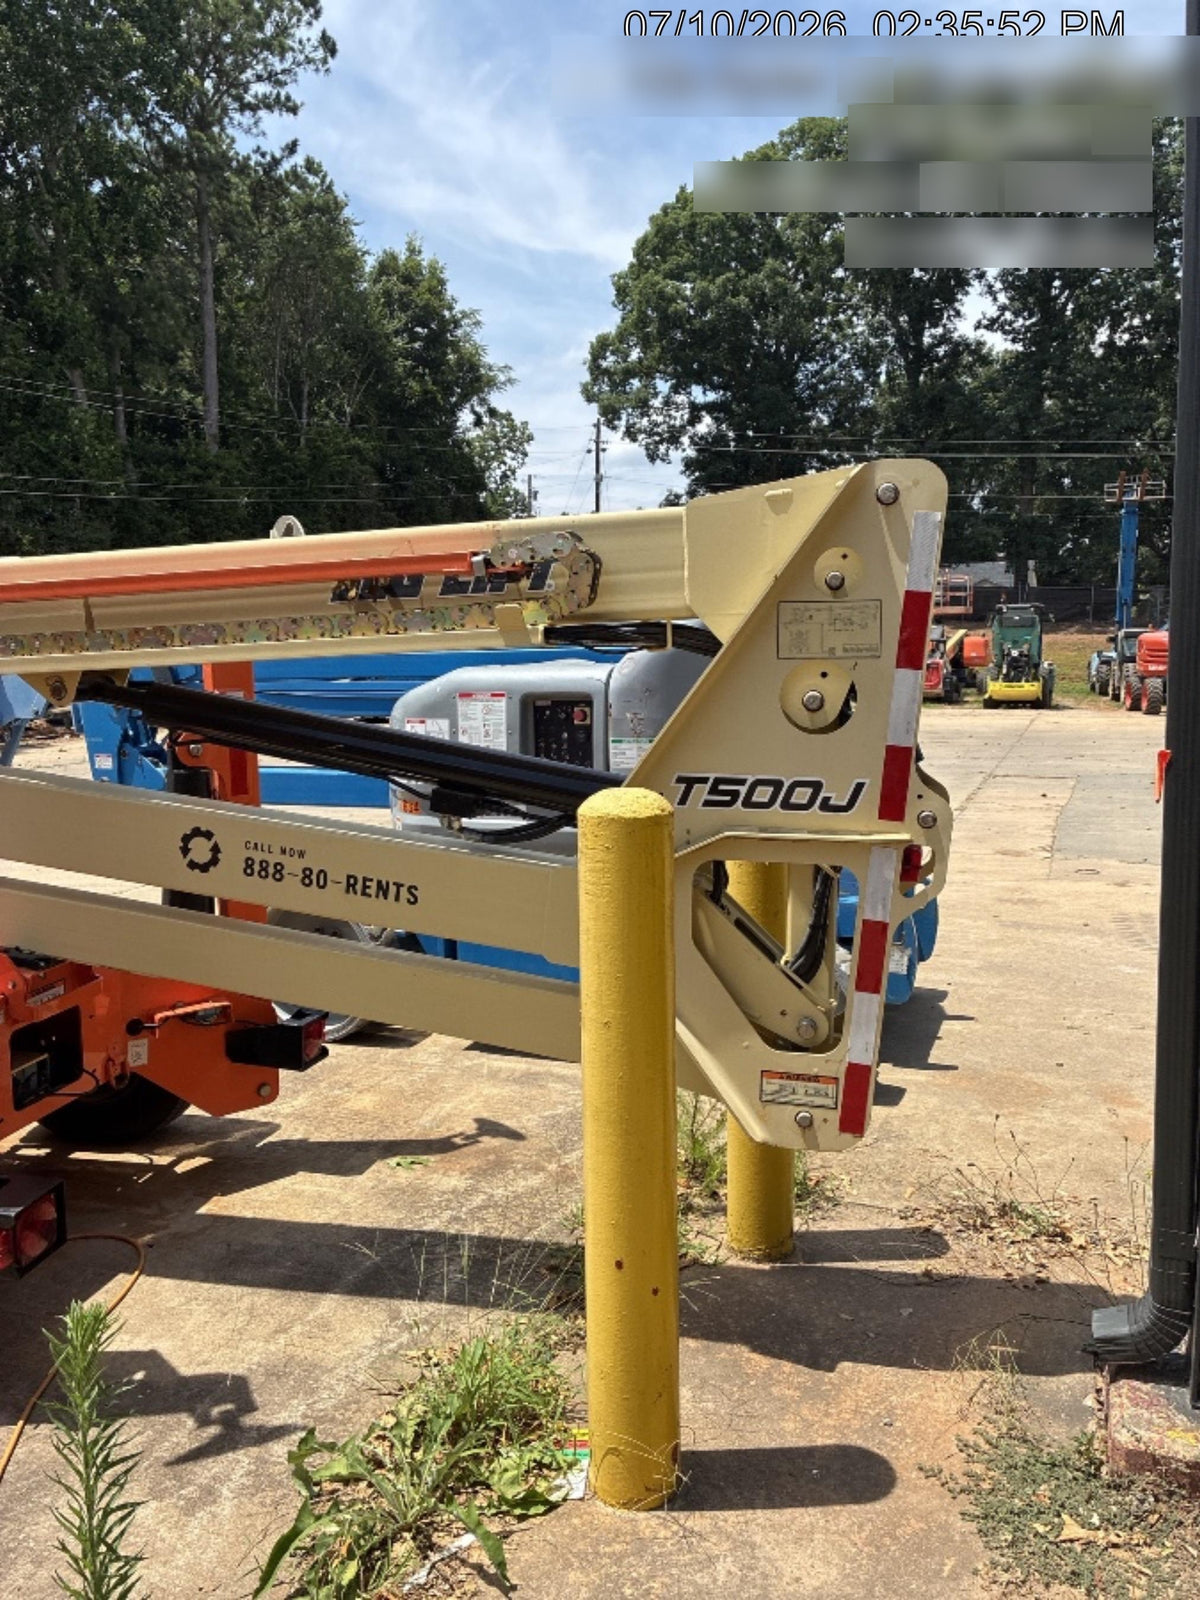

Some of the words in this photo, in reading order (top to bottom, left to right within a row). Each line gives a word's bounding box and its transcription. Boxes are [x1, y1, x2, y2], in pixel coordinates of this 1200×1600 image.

[673, 774, 869, 814] T500J
[244, 840, 274, 854] CALL
[280, 845, 307, 860] NOW
[243, 856, 419, 906] 888-80-RENTS
